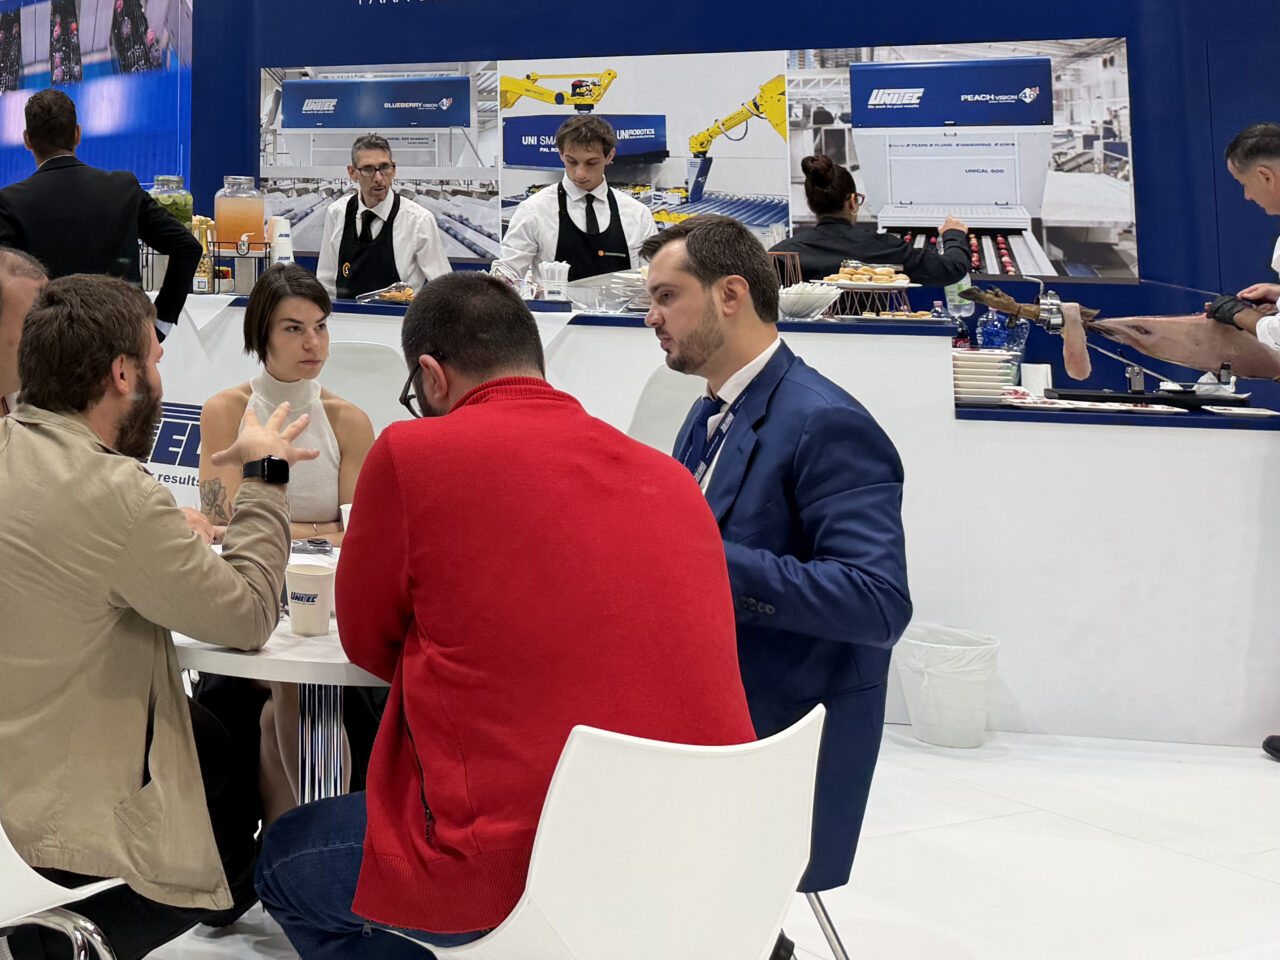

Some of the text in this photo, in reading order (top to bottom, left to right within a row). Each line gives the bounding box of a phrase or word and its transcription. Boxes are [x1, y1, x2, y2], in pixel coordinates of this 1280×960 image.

[867, 88, 925, 104] UNITEC
[961, 94, 994, 102] PEACH
[302, 98, 338, 110] UNITEC
[522, 136, 537, 146] UNI
[290, 591, 318, 603] UNITEC
